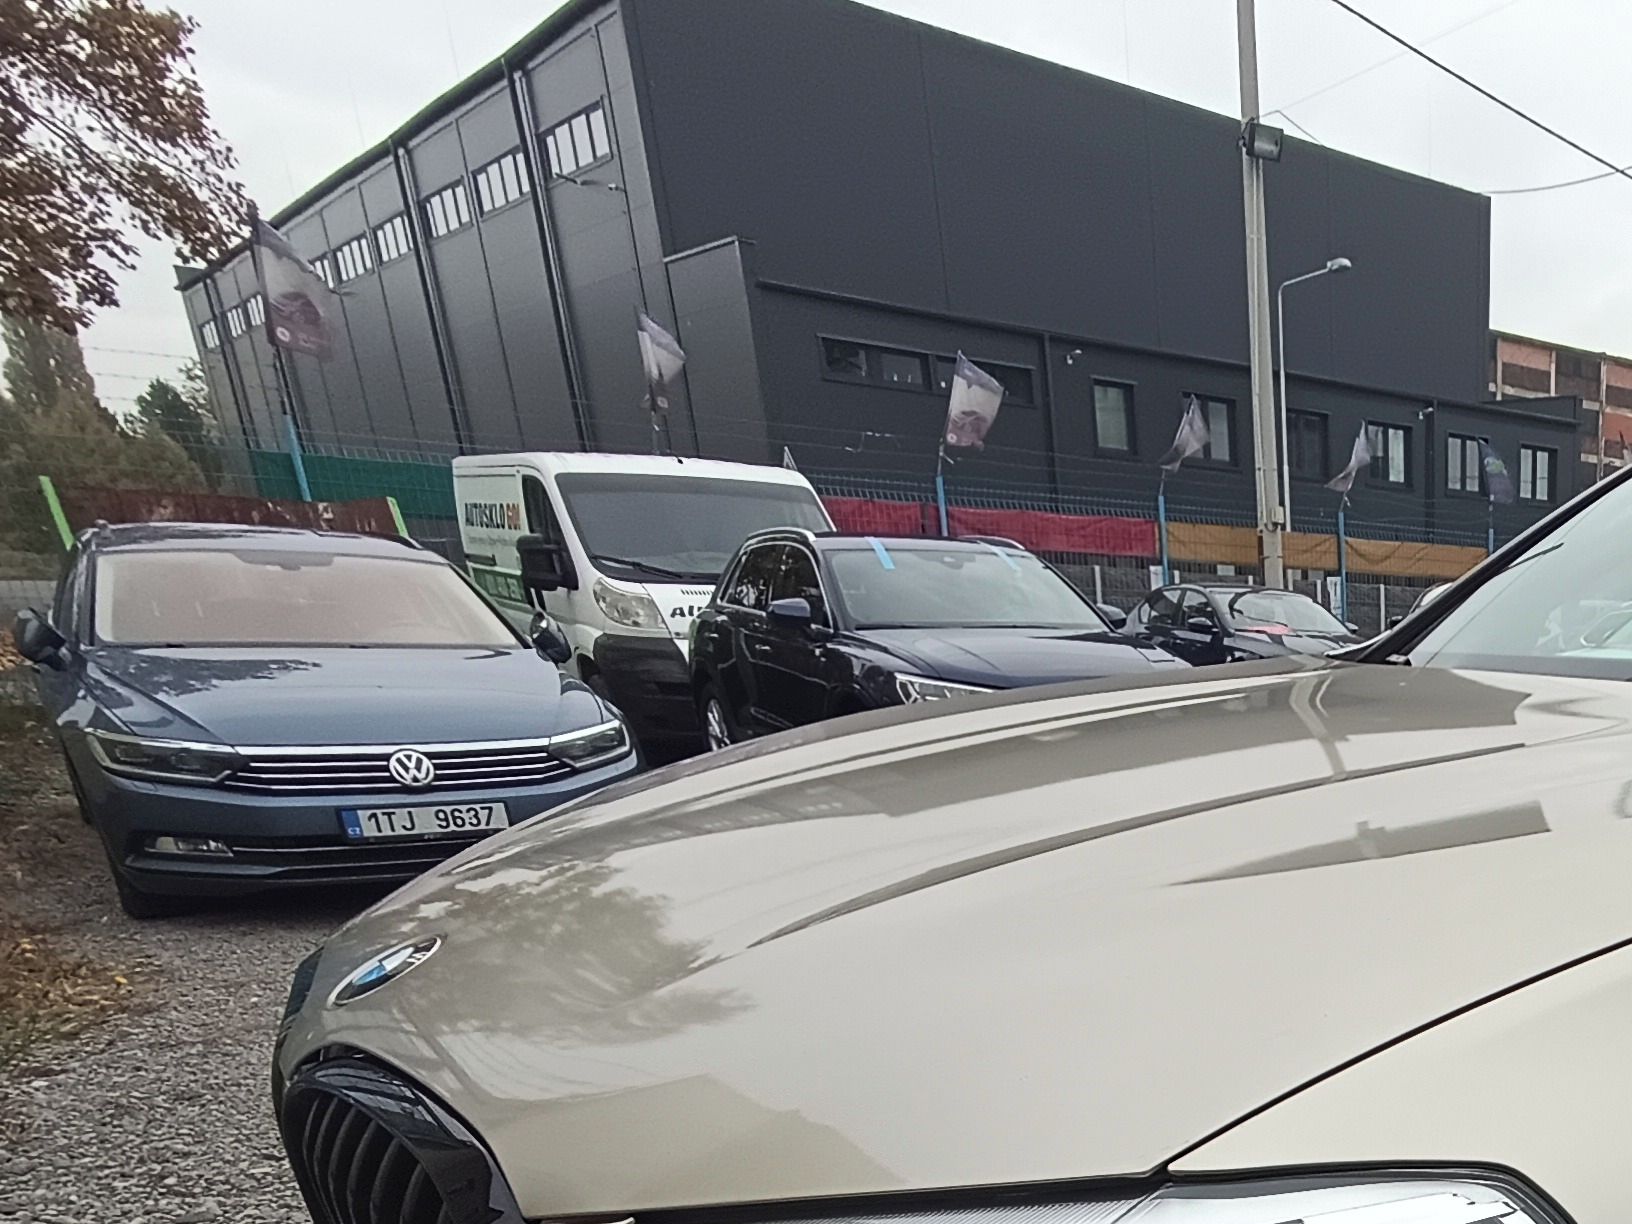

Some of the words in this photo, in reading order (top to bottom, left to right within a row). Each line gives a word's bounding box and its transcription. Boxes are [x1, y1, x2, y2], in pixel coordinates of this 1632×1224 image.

[465, 502, 505, 529] AUTOSKLO
[367, 810, 416, 834] 1TJ
[434, 806, 494, 830] 9637
